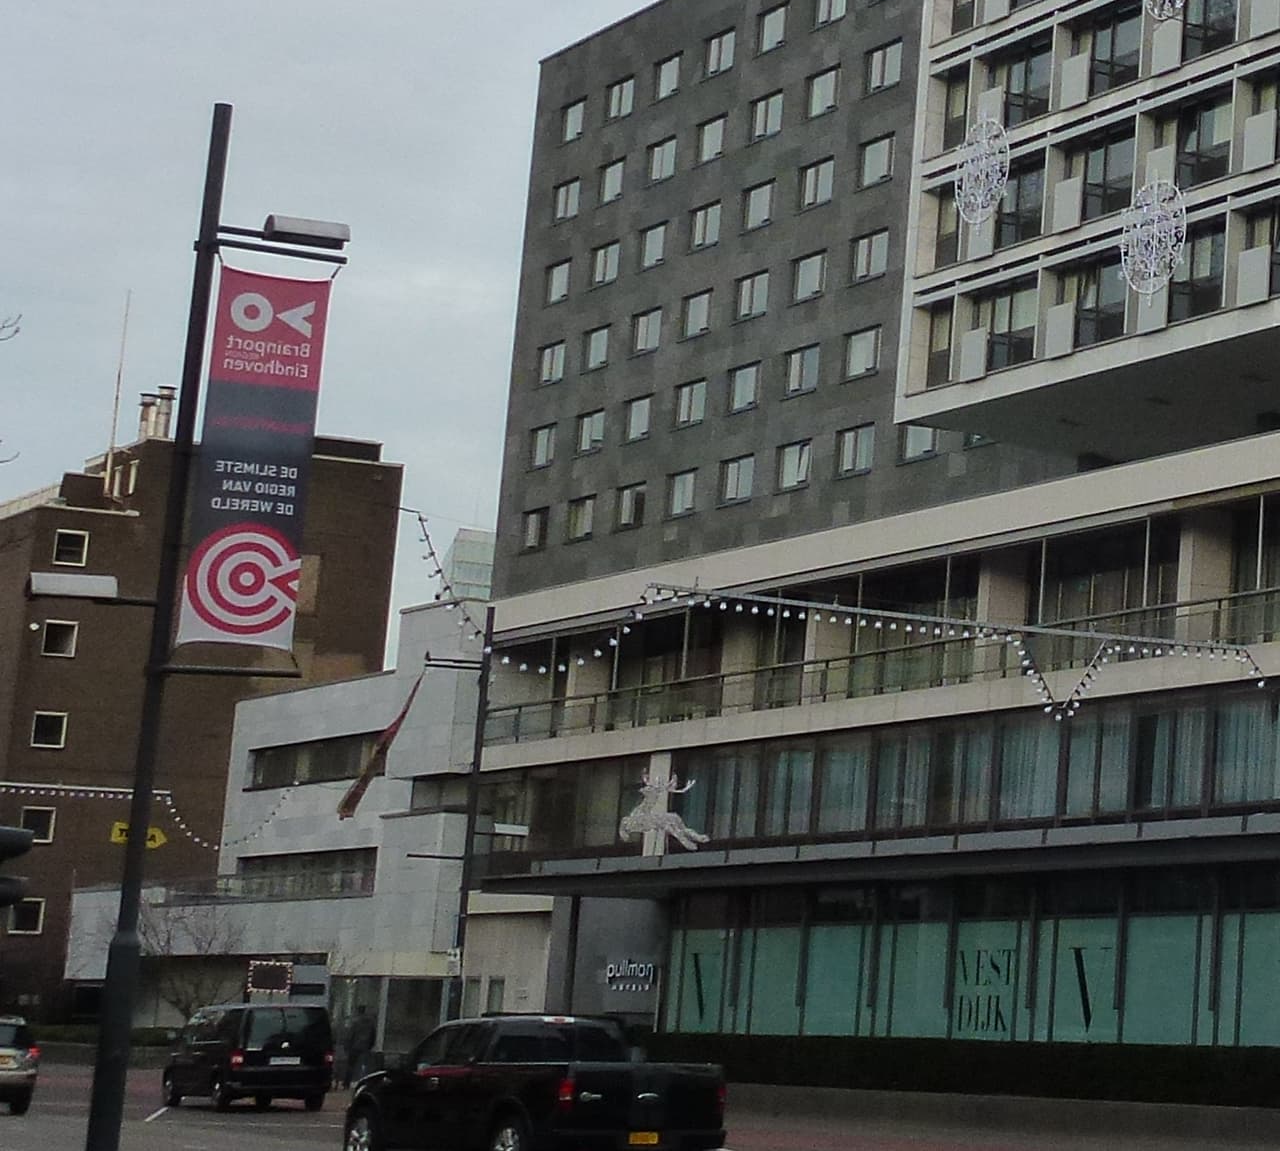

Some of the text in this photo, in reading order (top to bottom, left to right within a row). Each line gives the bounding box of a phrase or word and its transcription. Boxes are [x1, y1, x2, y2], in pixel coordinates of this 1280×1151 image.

[606, 959, 653, 984] pullman
[959, 949, 1017, 986] VEST
[958, 994, 1007, 1032] DIJK
